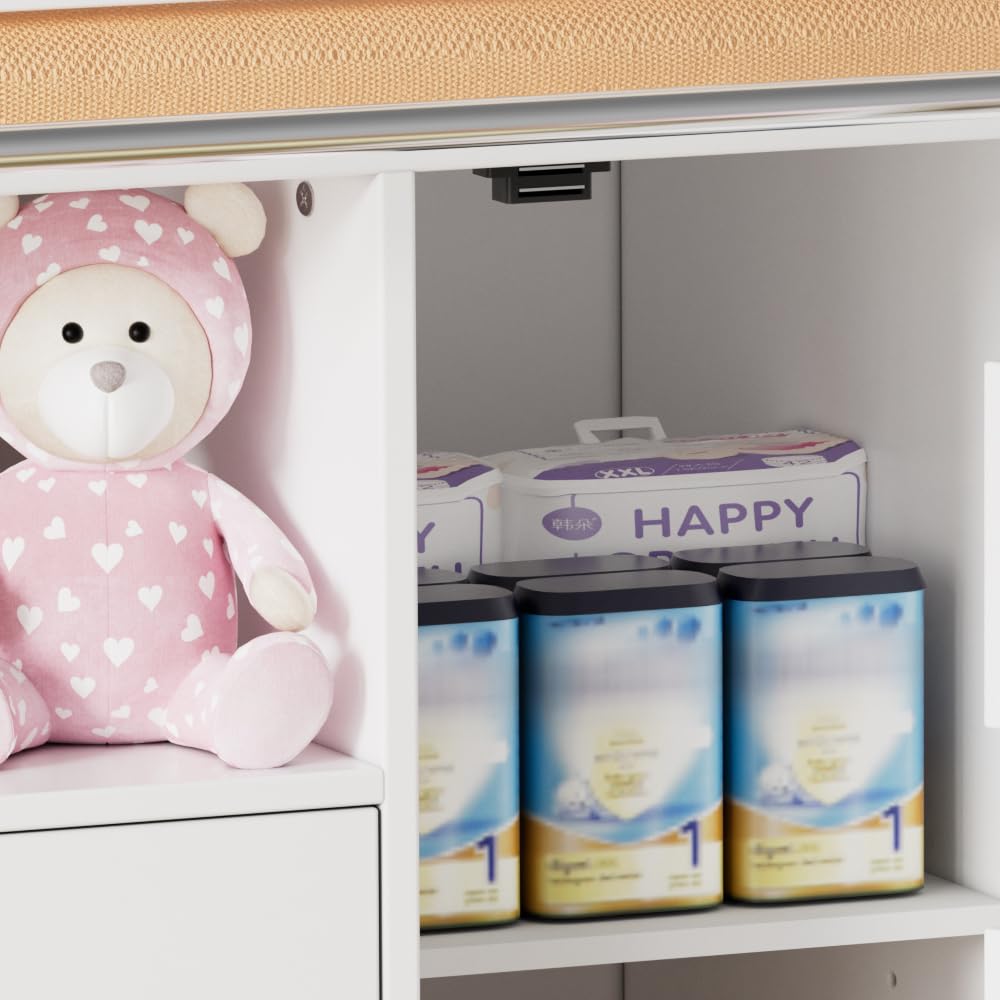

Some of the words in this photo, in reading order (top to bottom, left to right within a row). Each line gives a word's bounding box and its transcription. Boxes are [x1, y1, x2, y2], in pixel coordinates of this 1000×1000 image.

[600, 466, 652, 479] XXL
[634, 496, 814, 539] HAPPY
[681, 820, 700, 868] 1
[883, 804, 900, 852] 1
[476, 835, 495, 883] 1
